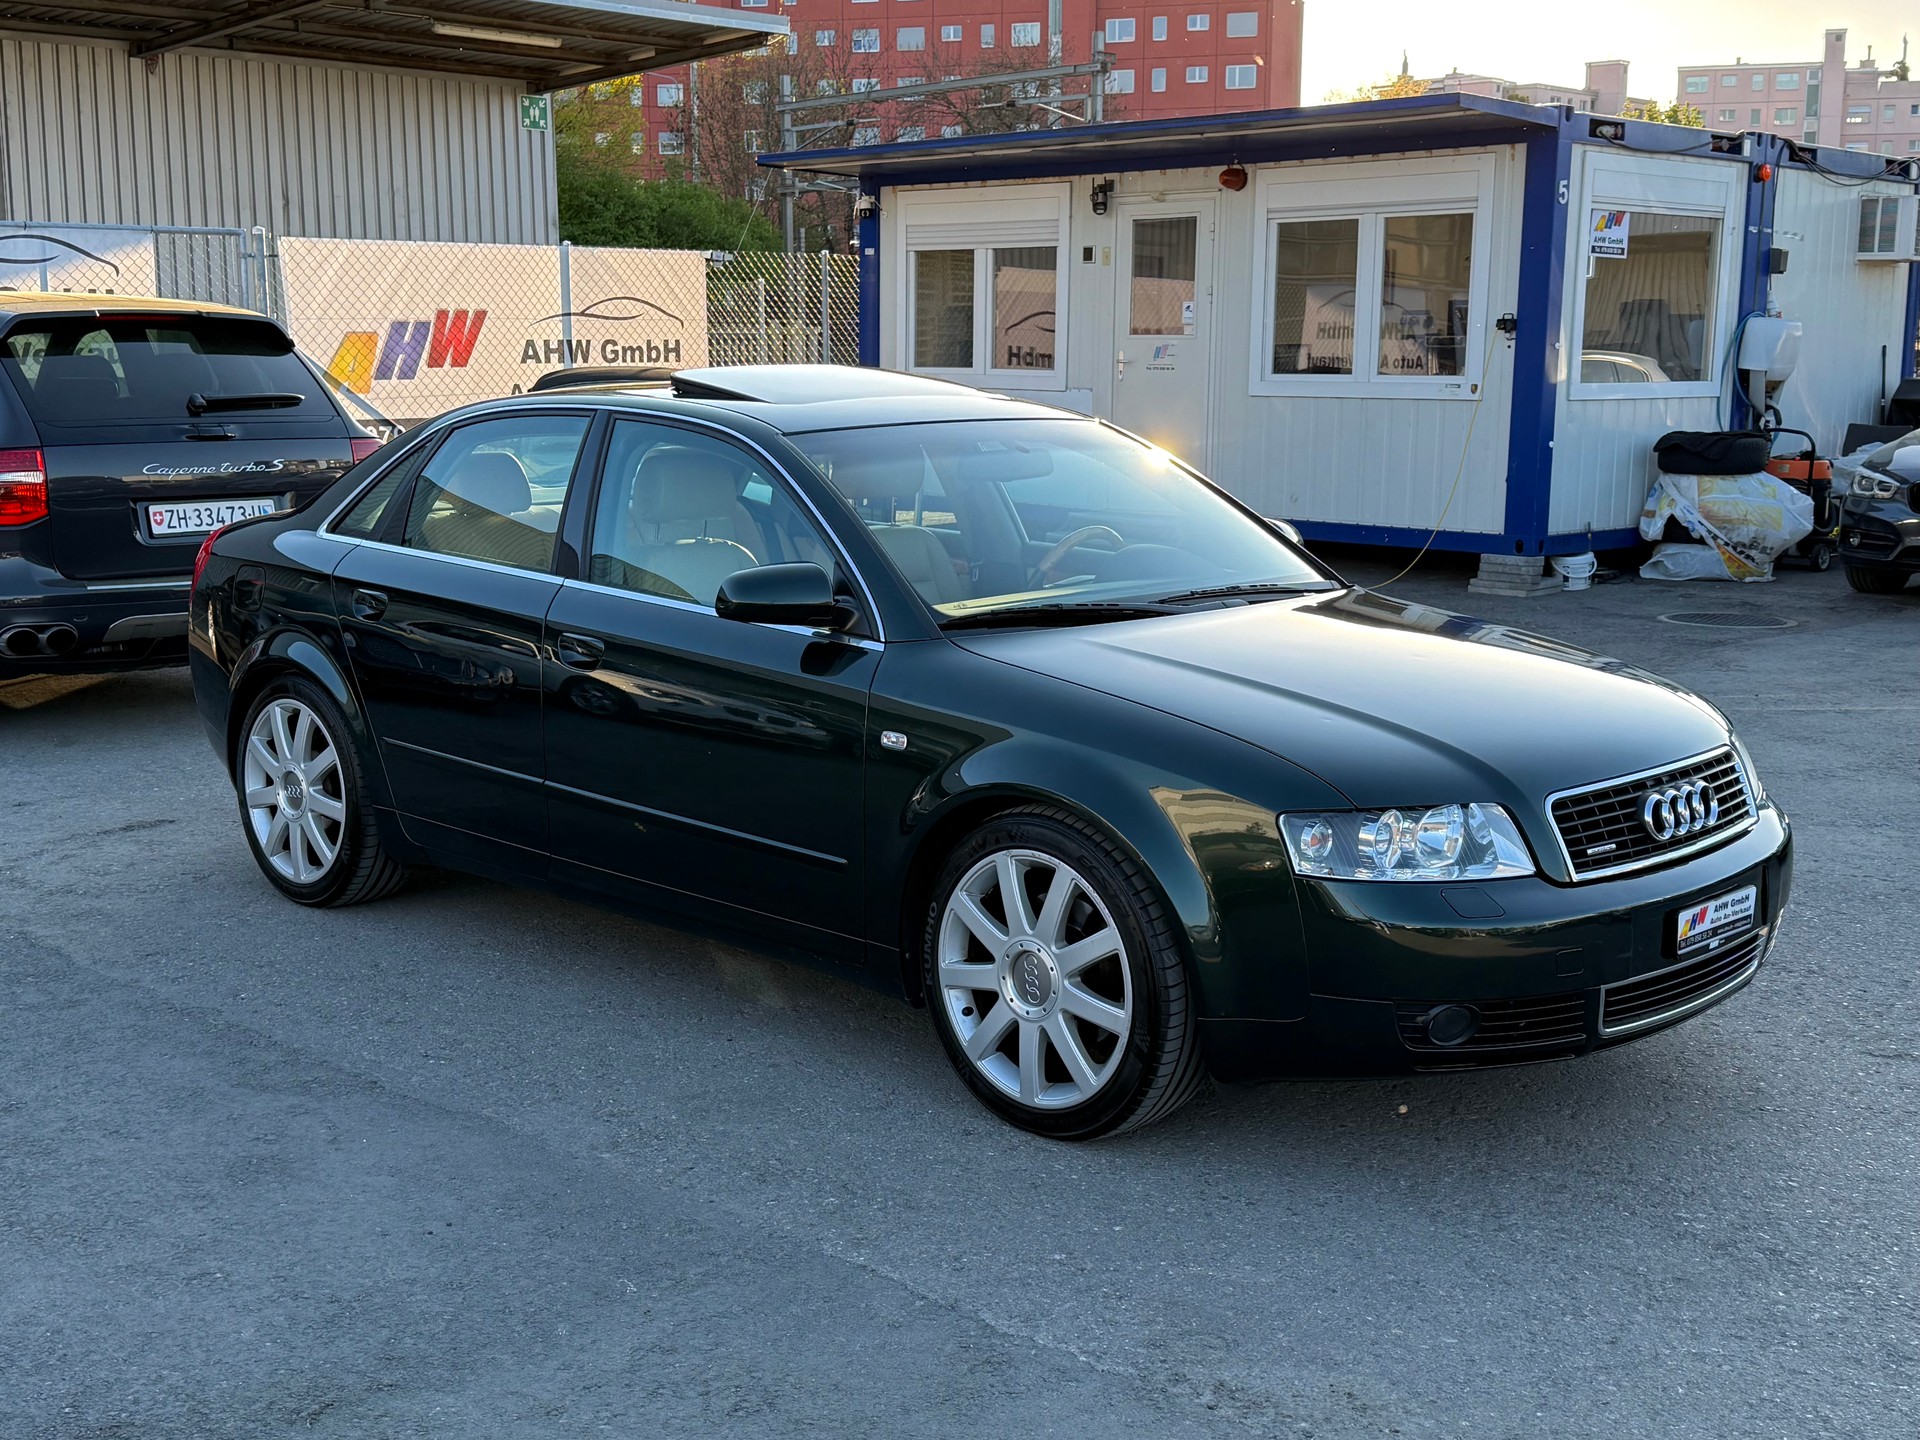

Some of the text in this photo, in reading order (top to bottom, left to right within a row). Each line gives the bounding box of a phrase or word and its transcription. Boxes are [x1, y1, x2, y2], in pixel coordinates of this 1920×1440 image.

[1559, 180, 1568, 204] 5
[323, 308, 488, 396] AHW
[520, 339, 681, 364] AHW GmbH
[143, 463, 216, 480] Cayenne
[1714, 894, 1750, 913] AHW GmbH
[1680, 905, 1709, 938] AHW
[1710, 917, 1722, 925] Auto
[923, 901, 938, 985] KUMHO
